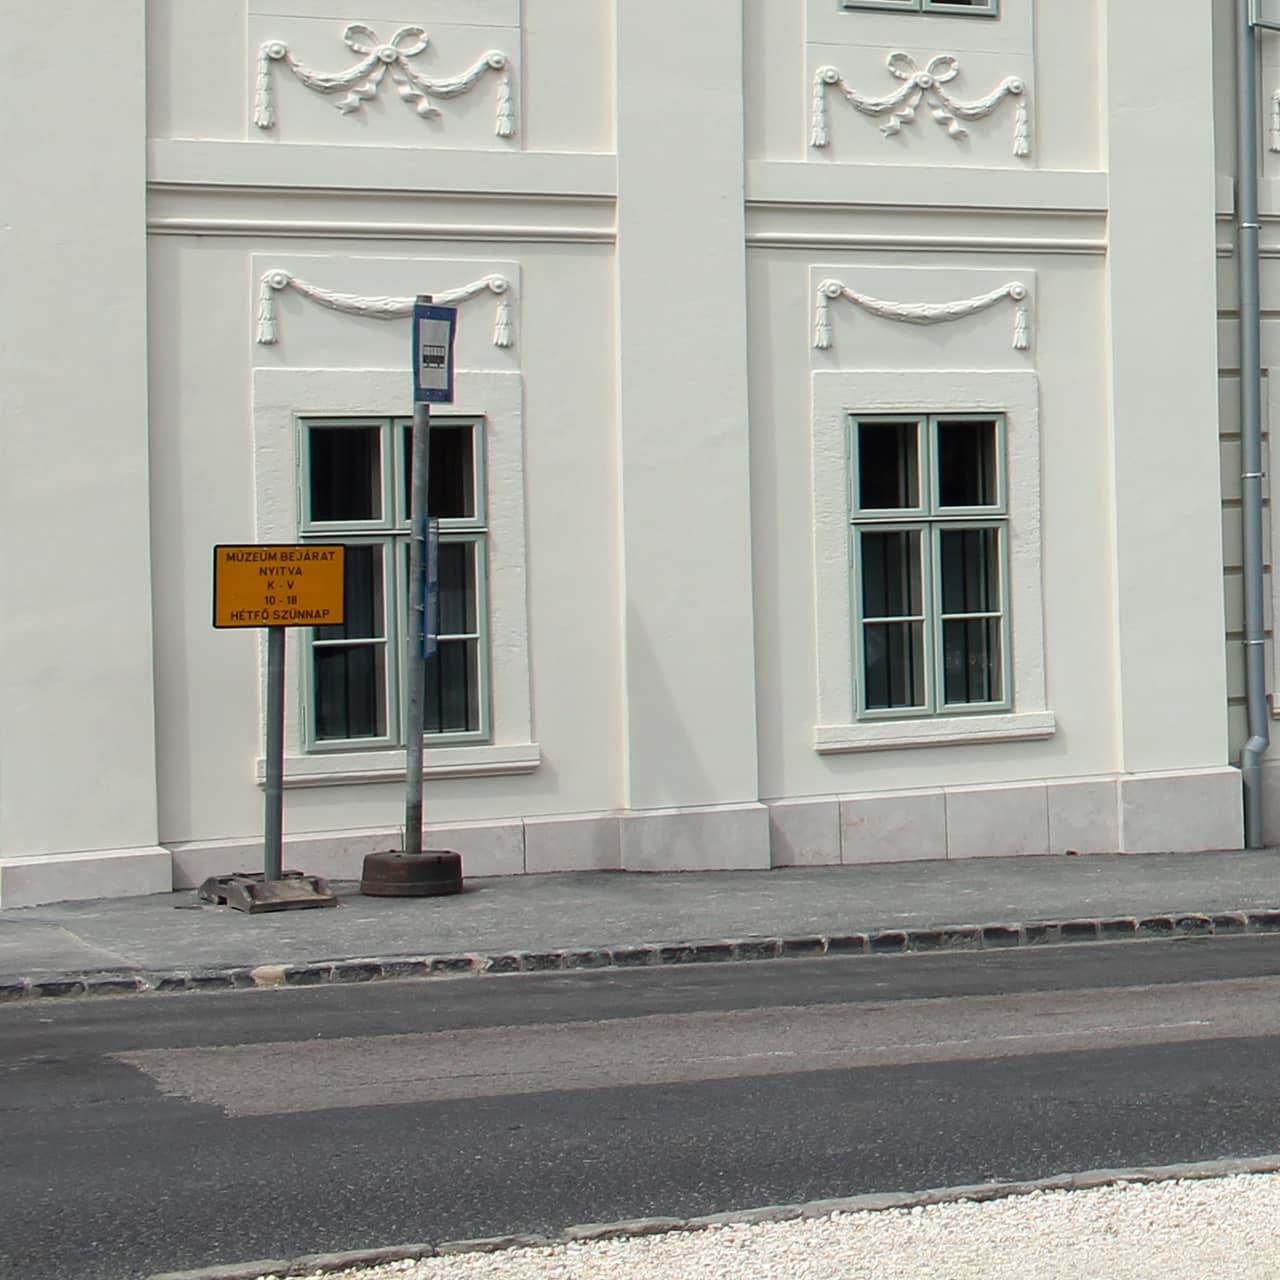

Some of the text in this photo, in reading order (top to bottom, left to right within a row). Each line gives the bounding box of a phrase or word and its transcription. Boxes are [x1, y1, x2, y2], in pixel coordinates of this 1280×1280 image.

[280, 549, 336, 562] BEJÁRAT
[259, 566, 303, 577] NYITVA
[267, 580, 275, 590] K
[287, 580, 295, 590] V
[264, 596, 276, 606] 10
[287, 595, 297, 605] 18
